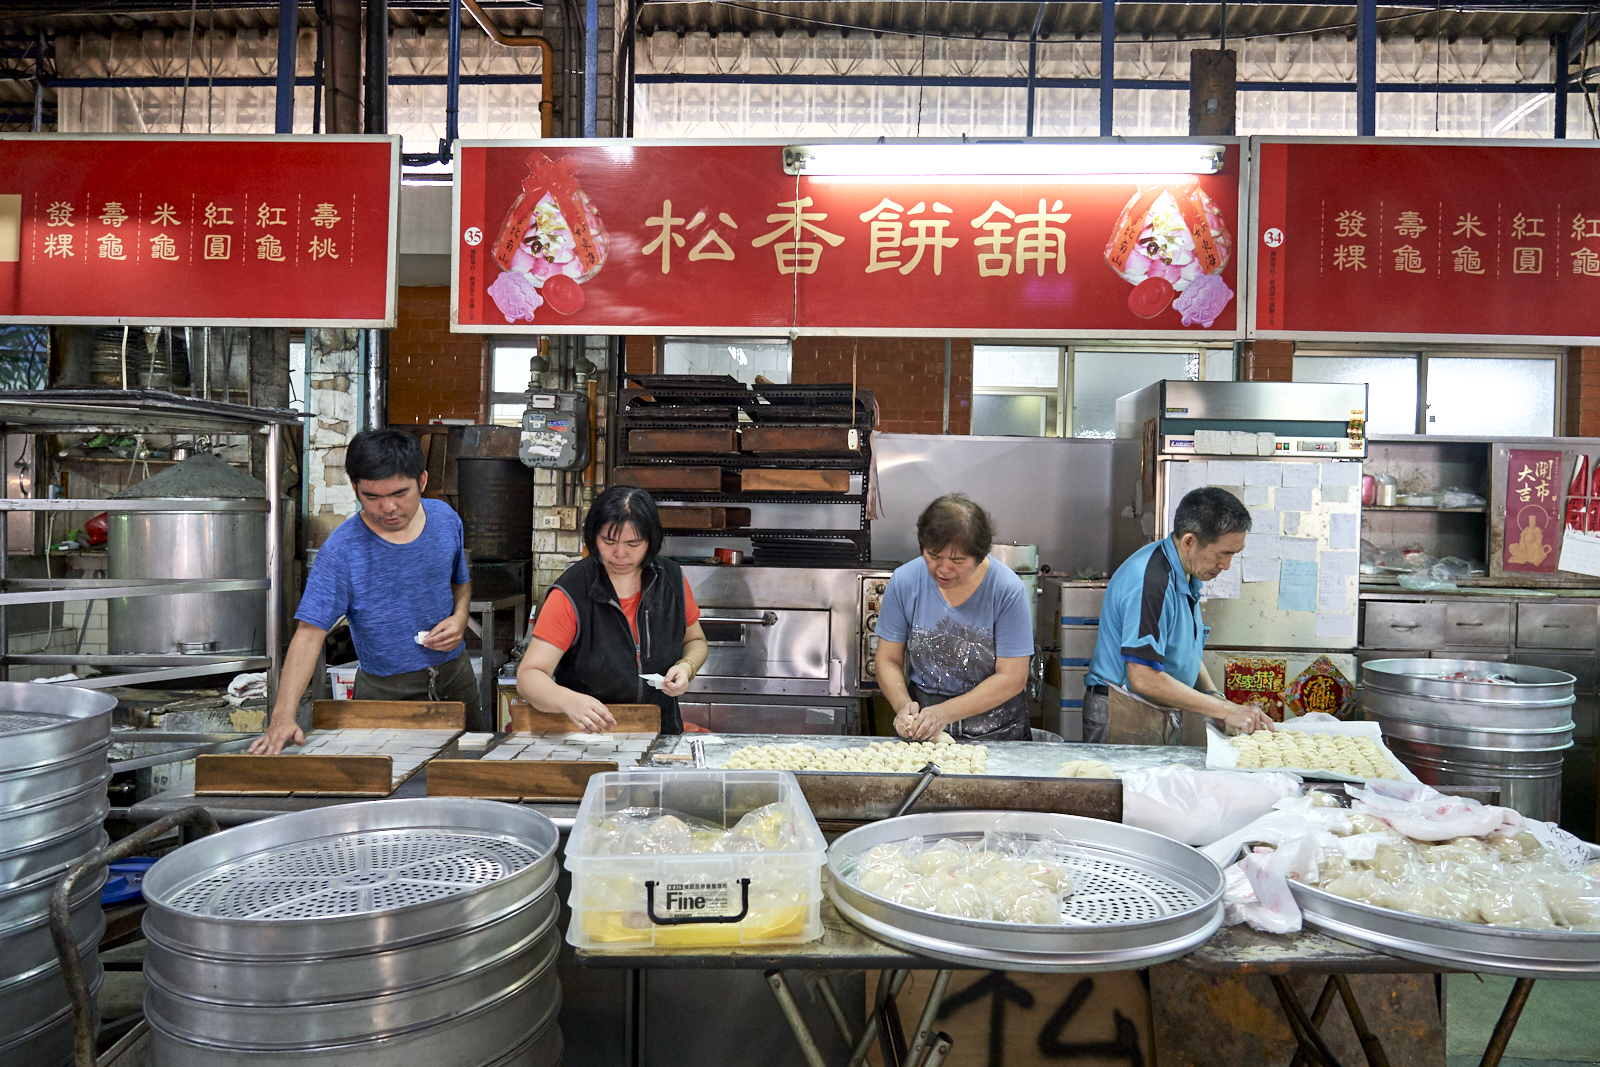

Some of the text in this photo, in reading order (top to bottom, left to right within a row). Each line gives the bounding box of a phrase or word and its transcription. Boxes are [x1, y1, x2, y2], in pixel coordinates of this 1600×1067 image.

[44, 200, 75, 259] 發粿
[97, 201, 129, 262] 壽龜
[149, 202, 182, 262] 米龜
[202, 202, 235, 260] 紅圓
[255, 202, 288, 263] 紅龜
[307, 202, 342, 261] 壽桃
[466, 230, 482, 243] 35
[641, 197, 1072, 278] 松香餅舖
[1265, 231, 1282, 244] 34
[1333, 209, 1368, 272] 發粿
[1392, 210, 1428, 274] 壽龜
[1451, 212, 1487, 275] 米龜
[1511, 212, 1546, 274] 紅圓
[1570, 213, 1600, 277] 紅龜
[1515, 464, 1537, 502] 大吉
[1534, 459, 1554, 503] 開市
[666, 891, 706, 910] Fine
